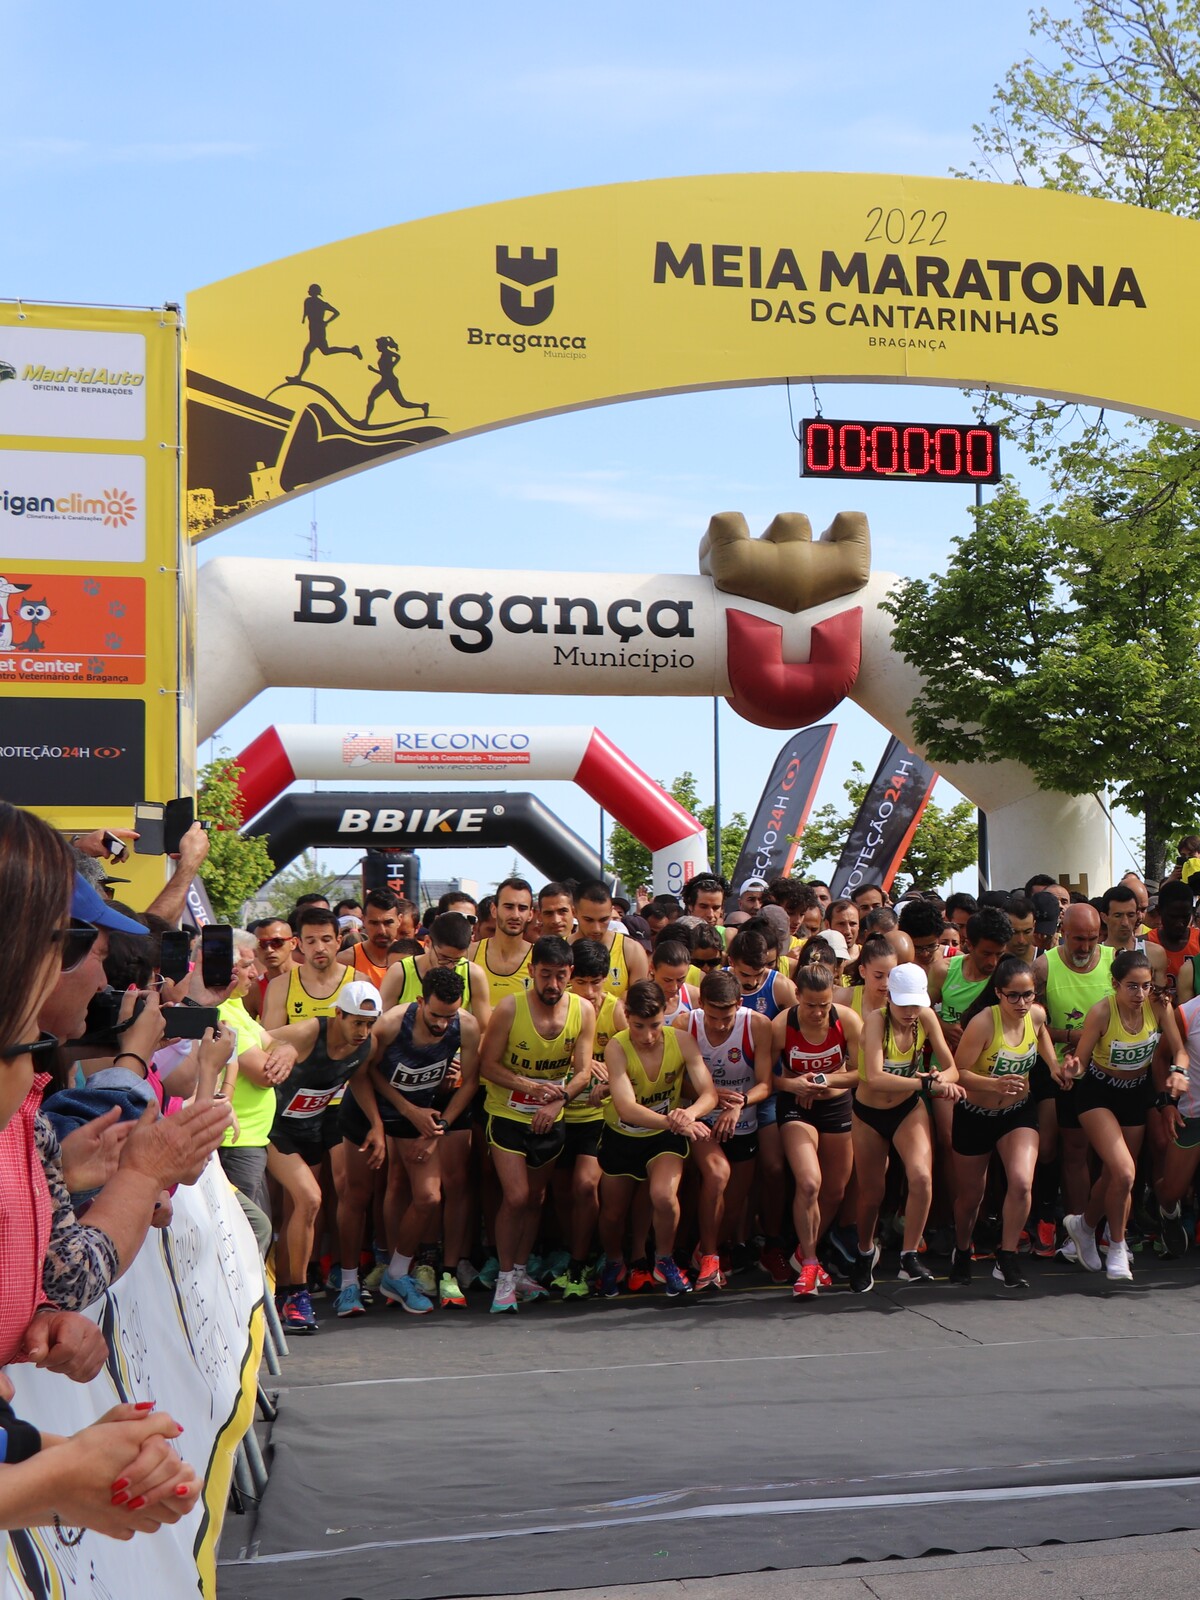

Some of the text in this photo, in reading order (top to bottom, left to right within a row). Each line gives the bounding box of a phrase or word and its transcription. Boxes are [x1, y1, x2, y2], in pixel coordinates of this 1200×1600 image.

[865, 207, 948, 246] 2022
[653, 241, 1147, 309] MEIA MARATONA
[750, 298, 1059, 337] DAS CANTARINHAS
[467, 327, 587, 353] Bragança
[868, 336, 947, 351] BRAGANÇA
[21, 364, 144, 386] MadridAuto
[33, 384, 65, 392] OFICINA
[807, 423, 992, 477] 00:00:00
[0, 490, 124, 516] iganclima
[293, 573, 695, 654] Bragança
[21, 658, 83, 673] Center
[553, 645, 695, 673] Município
[19, 672, 70, 681] Veterinário
[72, 673, 84, 681] de
[86, 674, 129, 683] Bragança
[396, 733, 530, 750] RECONCO
[1114, 1042, 1155, 1061] 3035
[800, 1056, 833, 1070] 105
[998, 1056, 1035, 1074] 3013
[400, 1068, 441, 1083] 1182
[1107, 1076, 1138, 1089] NIKE
[301, 1094, 332, 1109] 139
